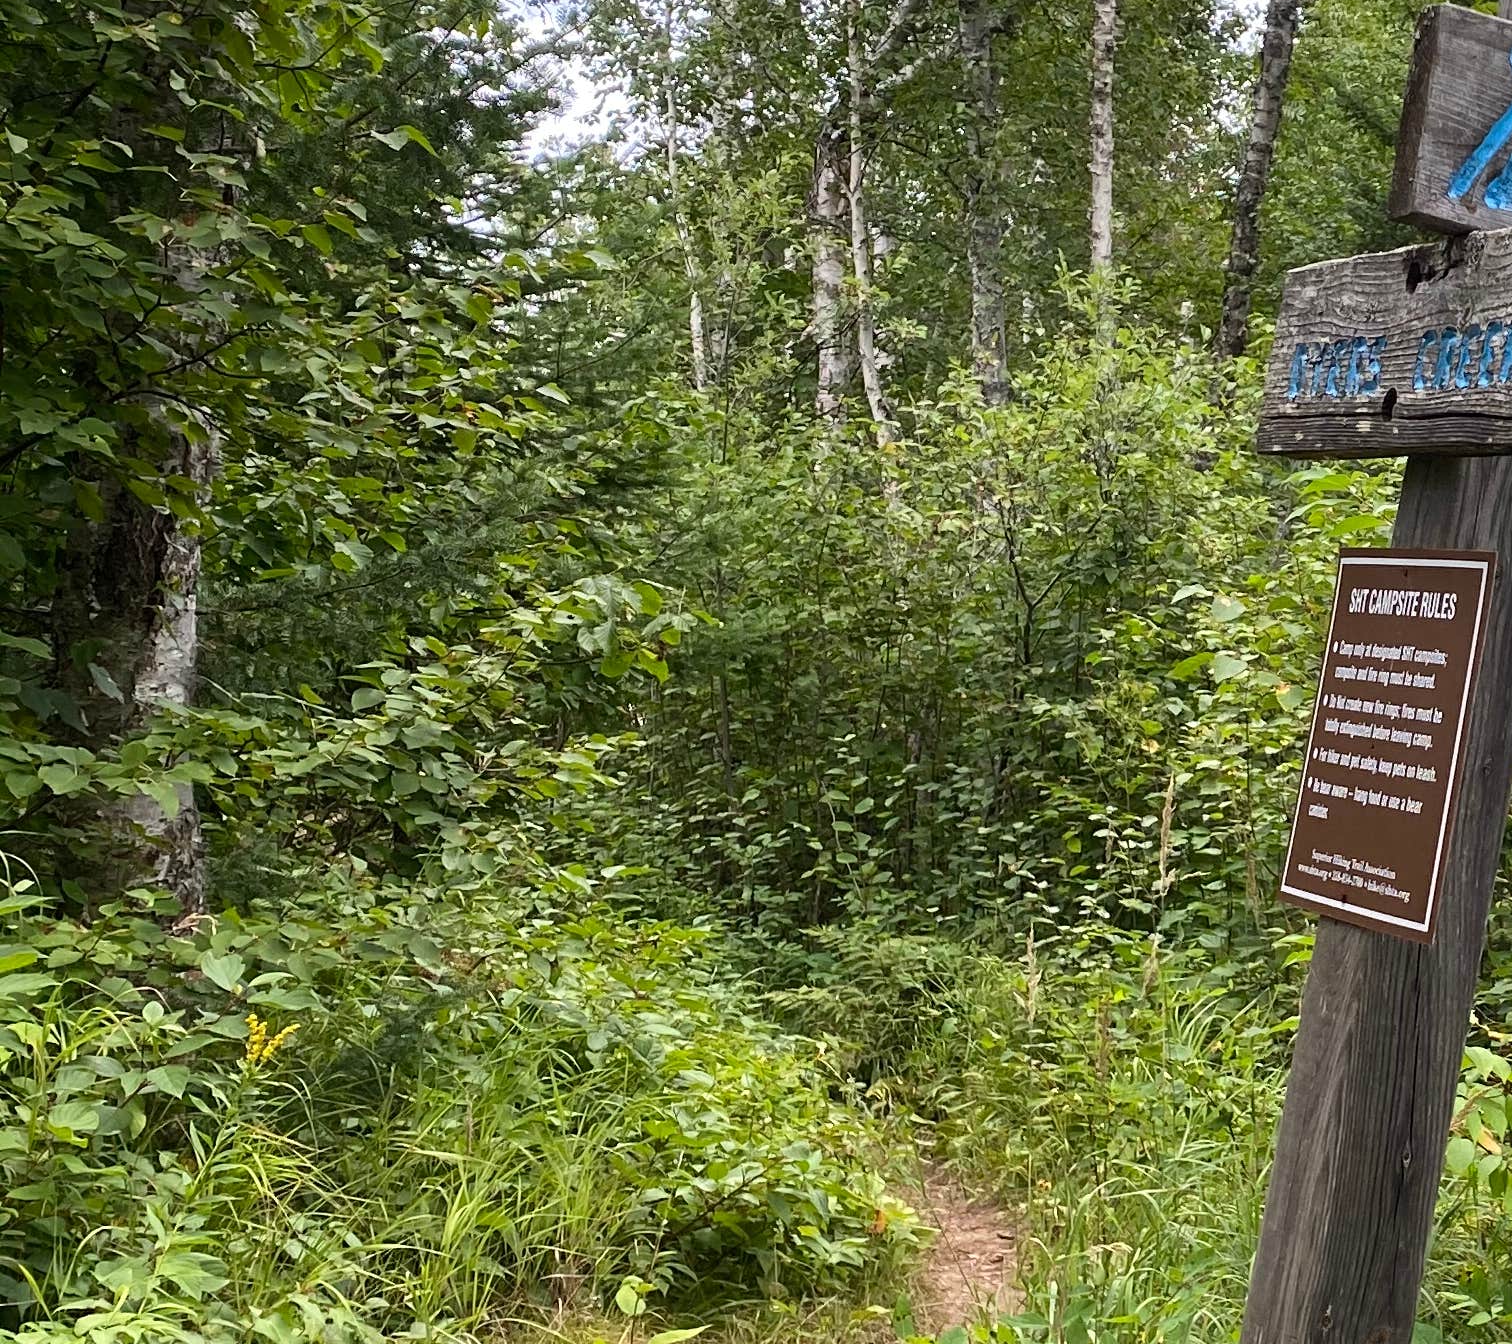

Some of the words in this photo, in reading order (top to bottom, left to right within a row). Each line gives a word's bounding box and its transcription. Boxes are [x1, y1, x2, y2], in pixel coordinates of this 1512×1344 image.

[1349, 588, 1369, 613] SHT
[1368, 589, 1420, 617] CAMPSITE
[1420, 592, 1456, 620] RULES
[1401, 646, 1415, 661] SHT
[1357, 666, 1369, 681] and
[1367, 667, 1378, 682] fire
[1376, 669, 1389, 687] ring
[1389, 670, 1405, 685] must
[1404, 671, 1412, 686] be
[1362, 701, 1374, 713] new
[1374, 700, 1385, 715] fire
[1401, 703, 1416, 719] fires
[1415, 707, 1433, 722] must
[1433, 707, 1443, 723] be
[1390, 726, 1413, 748] leaving
[1340, 752, 1352, 766] and
[1392, 762, 1407, 778] pets
[1406, 765, 1416, 778] on
[1415, 764, 1437, 782] leash.
[1368, 789, 1382, 805] food
[1381, 794, 1389, 807] or
[1388, 796, 1401, 810] use
[1400, 798, 1406, 811] a
[1405, 796, 1423, 814] bear
[1312, 848, 1333, 863] Superior
[1332, 853, 1351, 871] Hiking
[1351, 859, 1365, 872] Trail
[1364, 861, 1396, 879] Association
